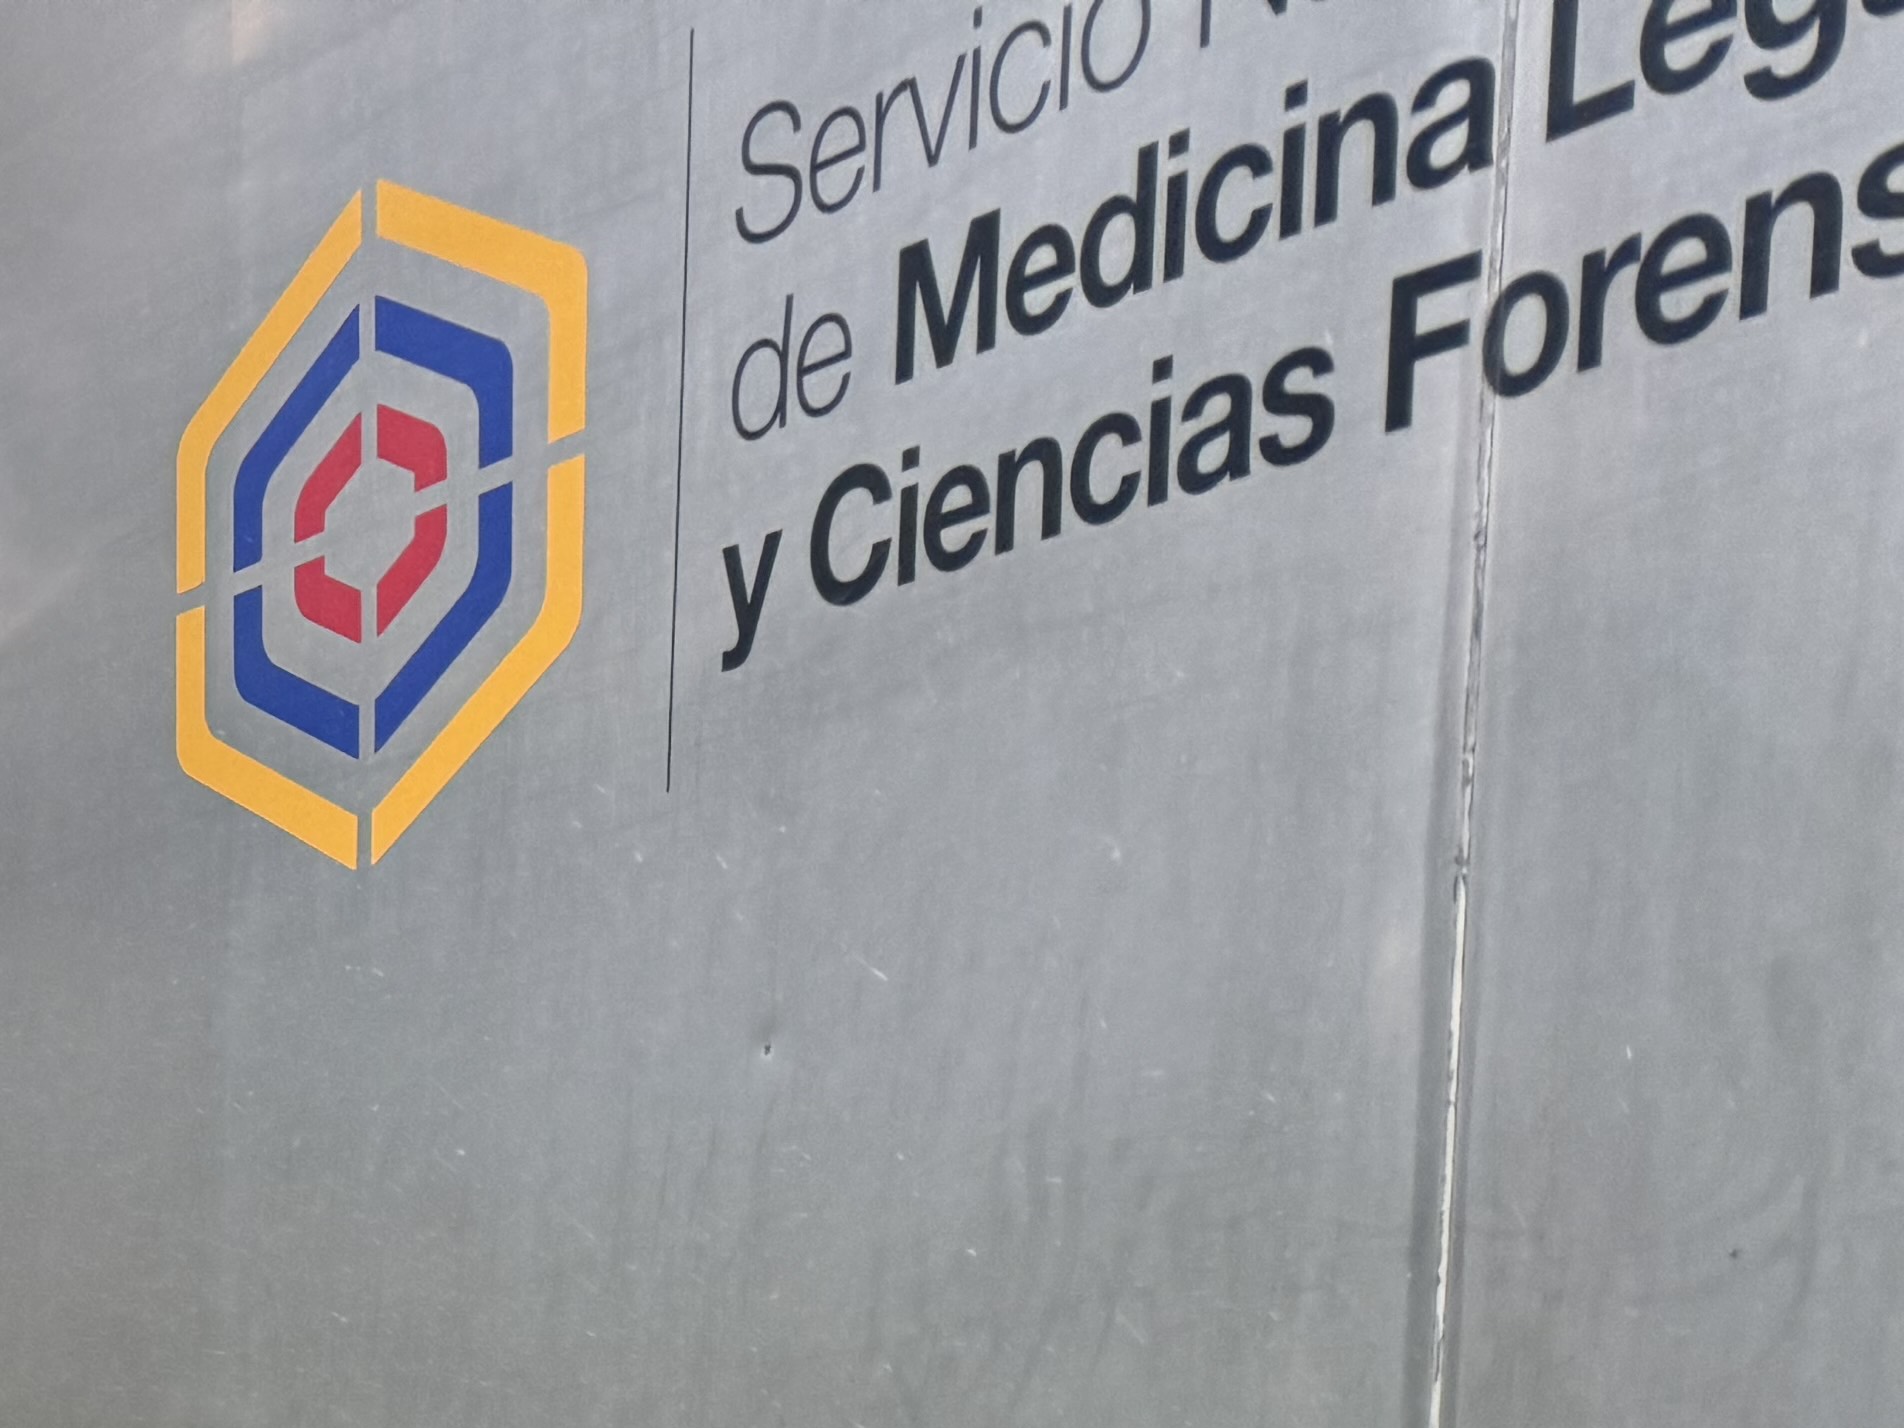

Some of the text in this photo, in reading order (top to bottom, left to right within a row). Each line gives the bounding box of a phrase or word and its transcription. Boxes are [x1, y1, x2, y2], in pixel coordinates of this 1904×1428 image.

[732, 0, 1904, 441] de Medicina Leg
[735, 0, 1151, 244] Servicio
[721, 529, 783, 672] y
[809, 346, 1336, 606] Ciencias
